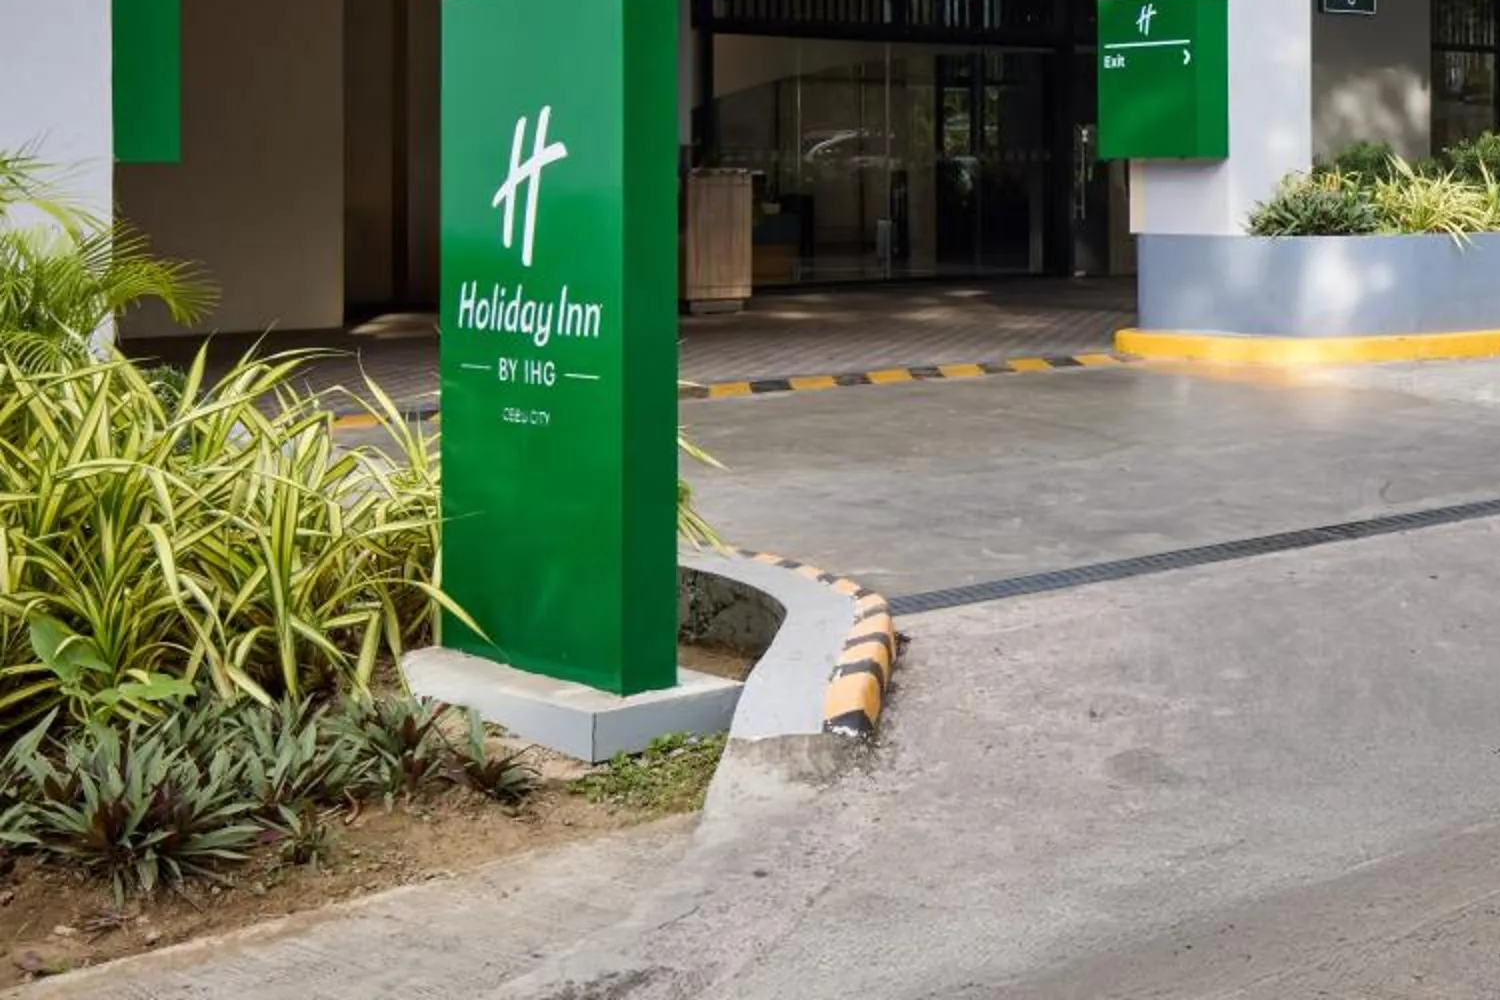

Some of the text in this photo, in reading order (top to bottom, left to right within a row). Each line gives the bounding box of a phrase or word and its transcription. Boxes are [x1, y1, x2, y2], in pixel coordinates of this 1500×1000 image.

[1103, 53, 1126, 69] Exit
[458, 280, 602, 348] Holiday Inn
[498, 356, 556, 387] BY IHG
[530, 409, 550, 426] CITY
